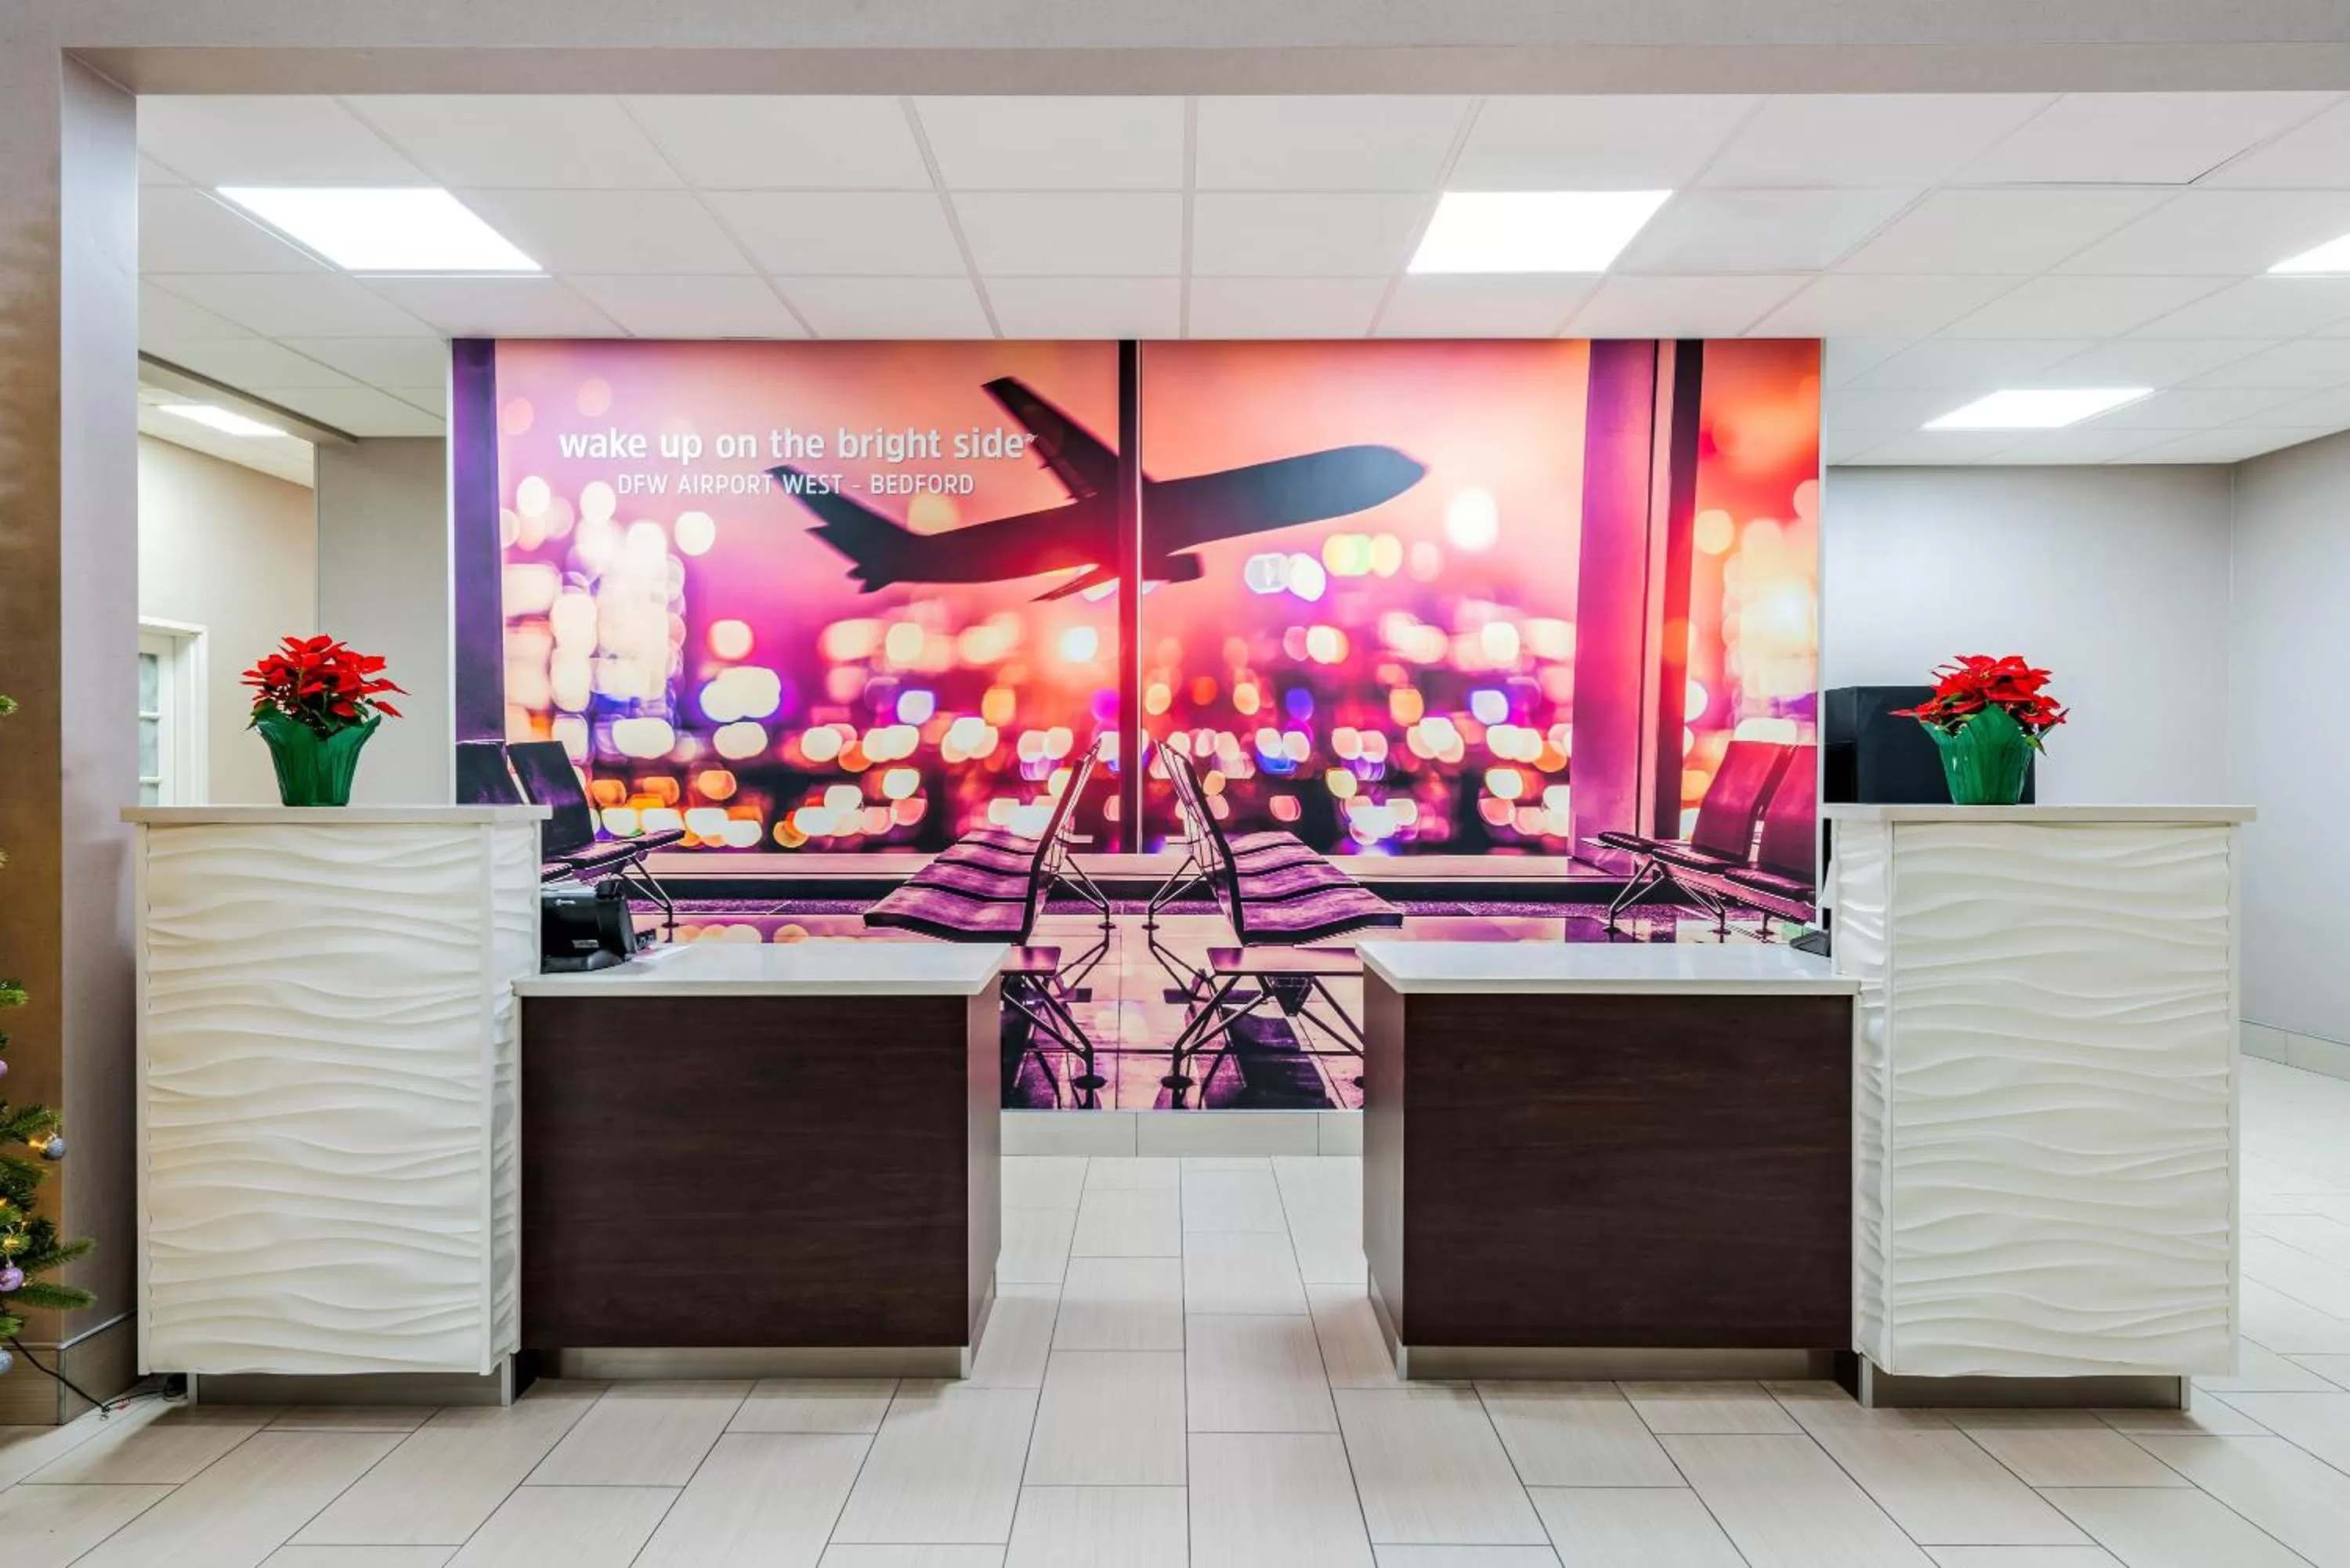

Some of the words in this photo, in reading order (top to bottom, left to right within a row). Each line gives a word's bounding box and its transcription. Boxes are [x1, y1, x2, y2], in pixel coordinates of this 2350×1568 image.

[559, 427, 647, 458] wake
[660, 433, 703, 466] up
[716, 433, 757, 458] on
[770, 428, 824, 458] the
[839, 428, 941, 463] bright
[618, 474, 668, 495] DFW
[677, 474, 773, 495] AIRPORT
[783, 474, 844, 495] WEST
[870, 474, 974, 495] BEDFORD
